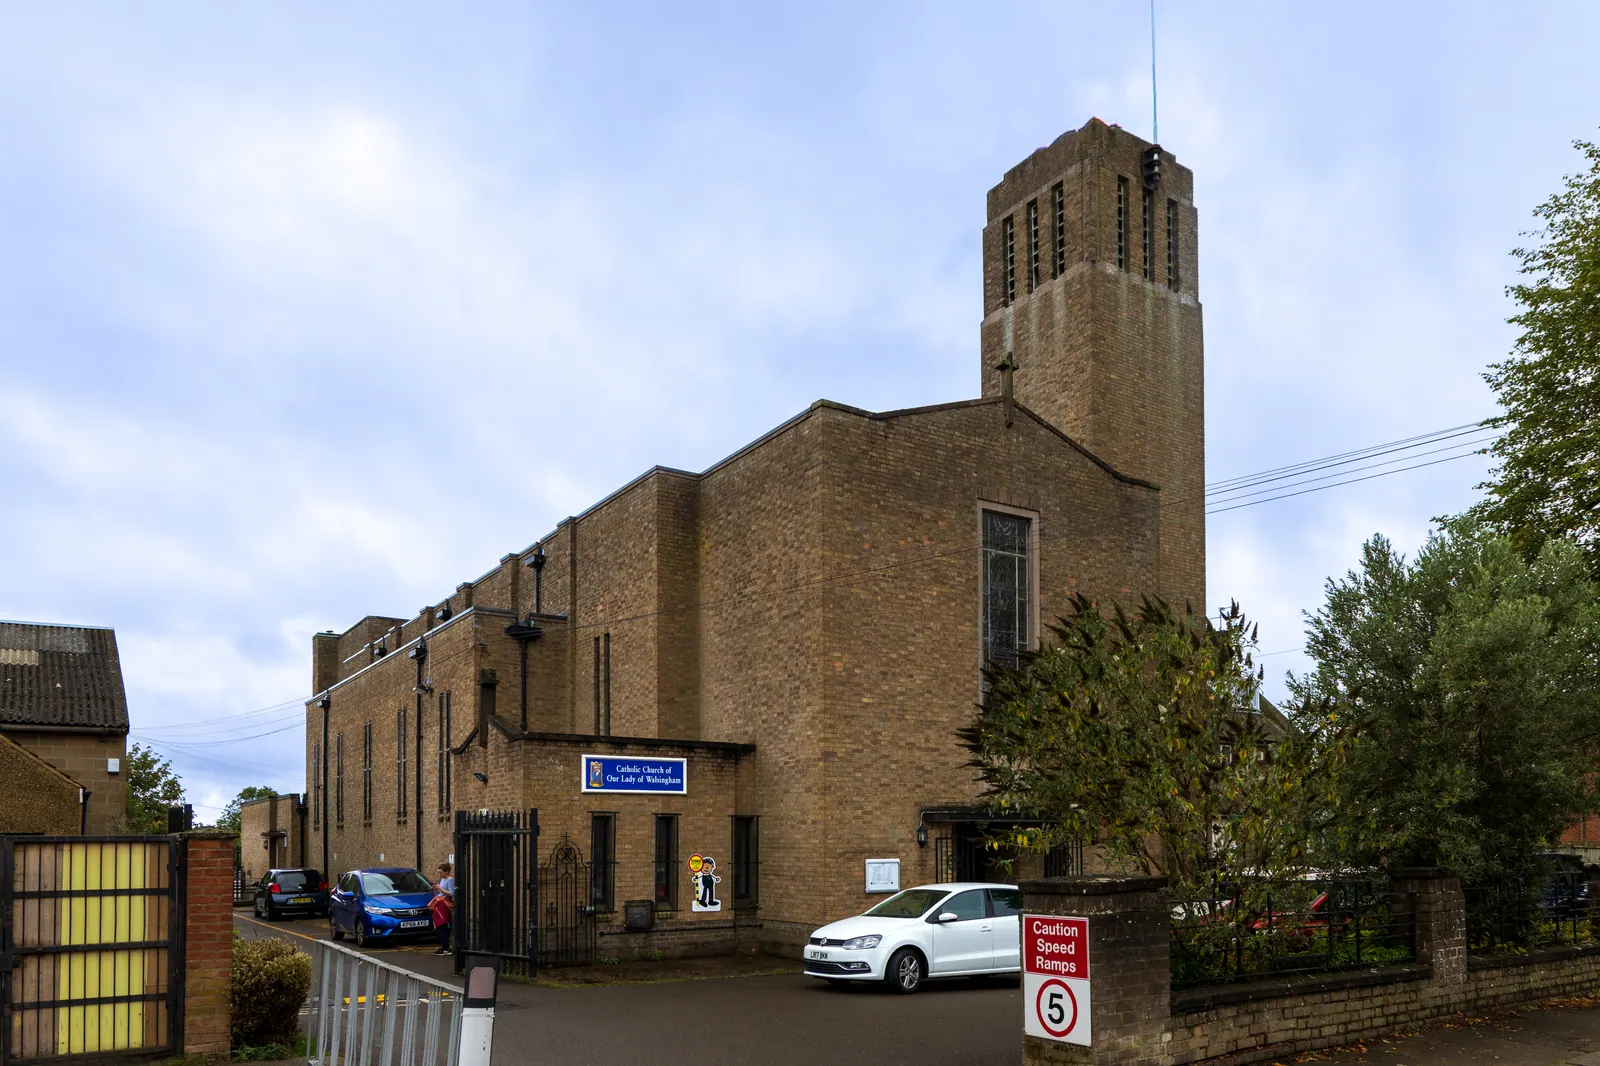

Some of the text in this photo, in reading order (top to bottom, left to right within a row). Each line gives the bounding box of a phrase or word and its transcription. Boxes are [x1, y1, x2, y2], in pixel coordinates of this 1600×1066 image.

[616, 765, 672, 774] Catholic Church of
[621, 775, 635, 785] Lady
[637, 775, 644, 783] of
[646, 776, 681, 785] Walsingham
[1033, 921, 1078, 937] Caution
[1036, 938, 1075, 955] Speed
[1036, 955, 1077, 974] Ramps
[1047, 992, 1065, 1024] 5
